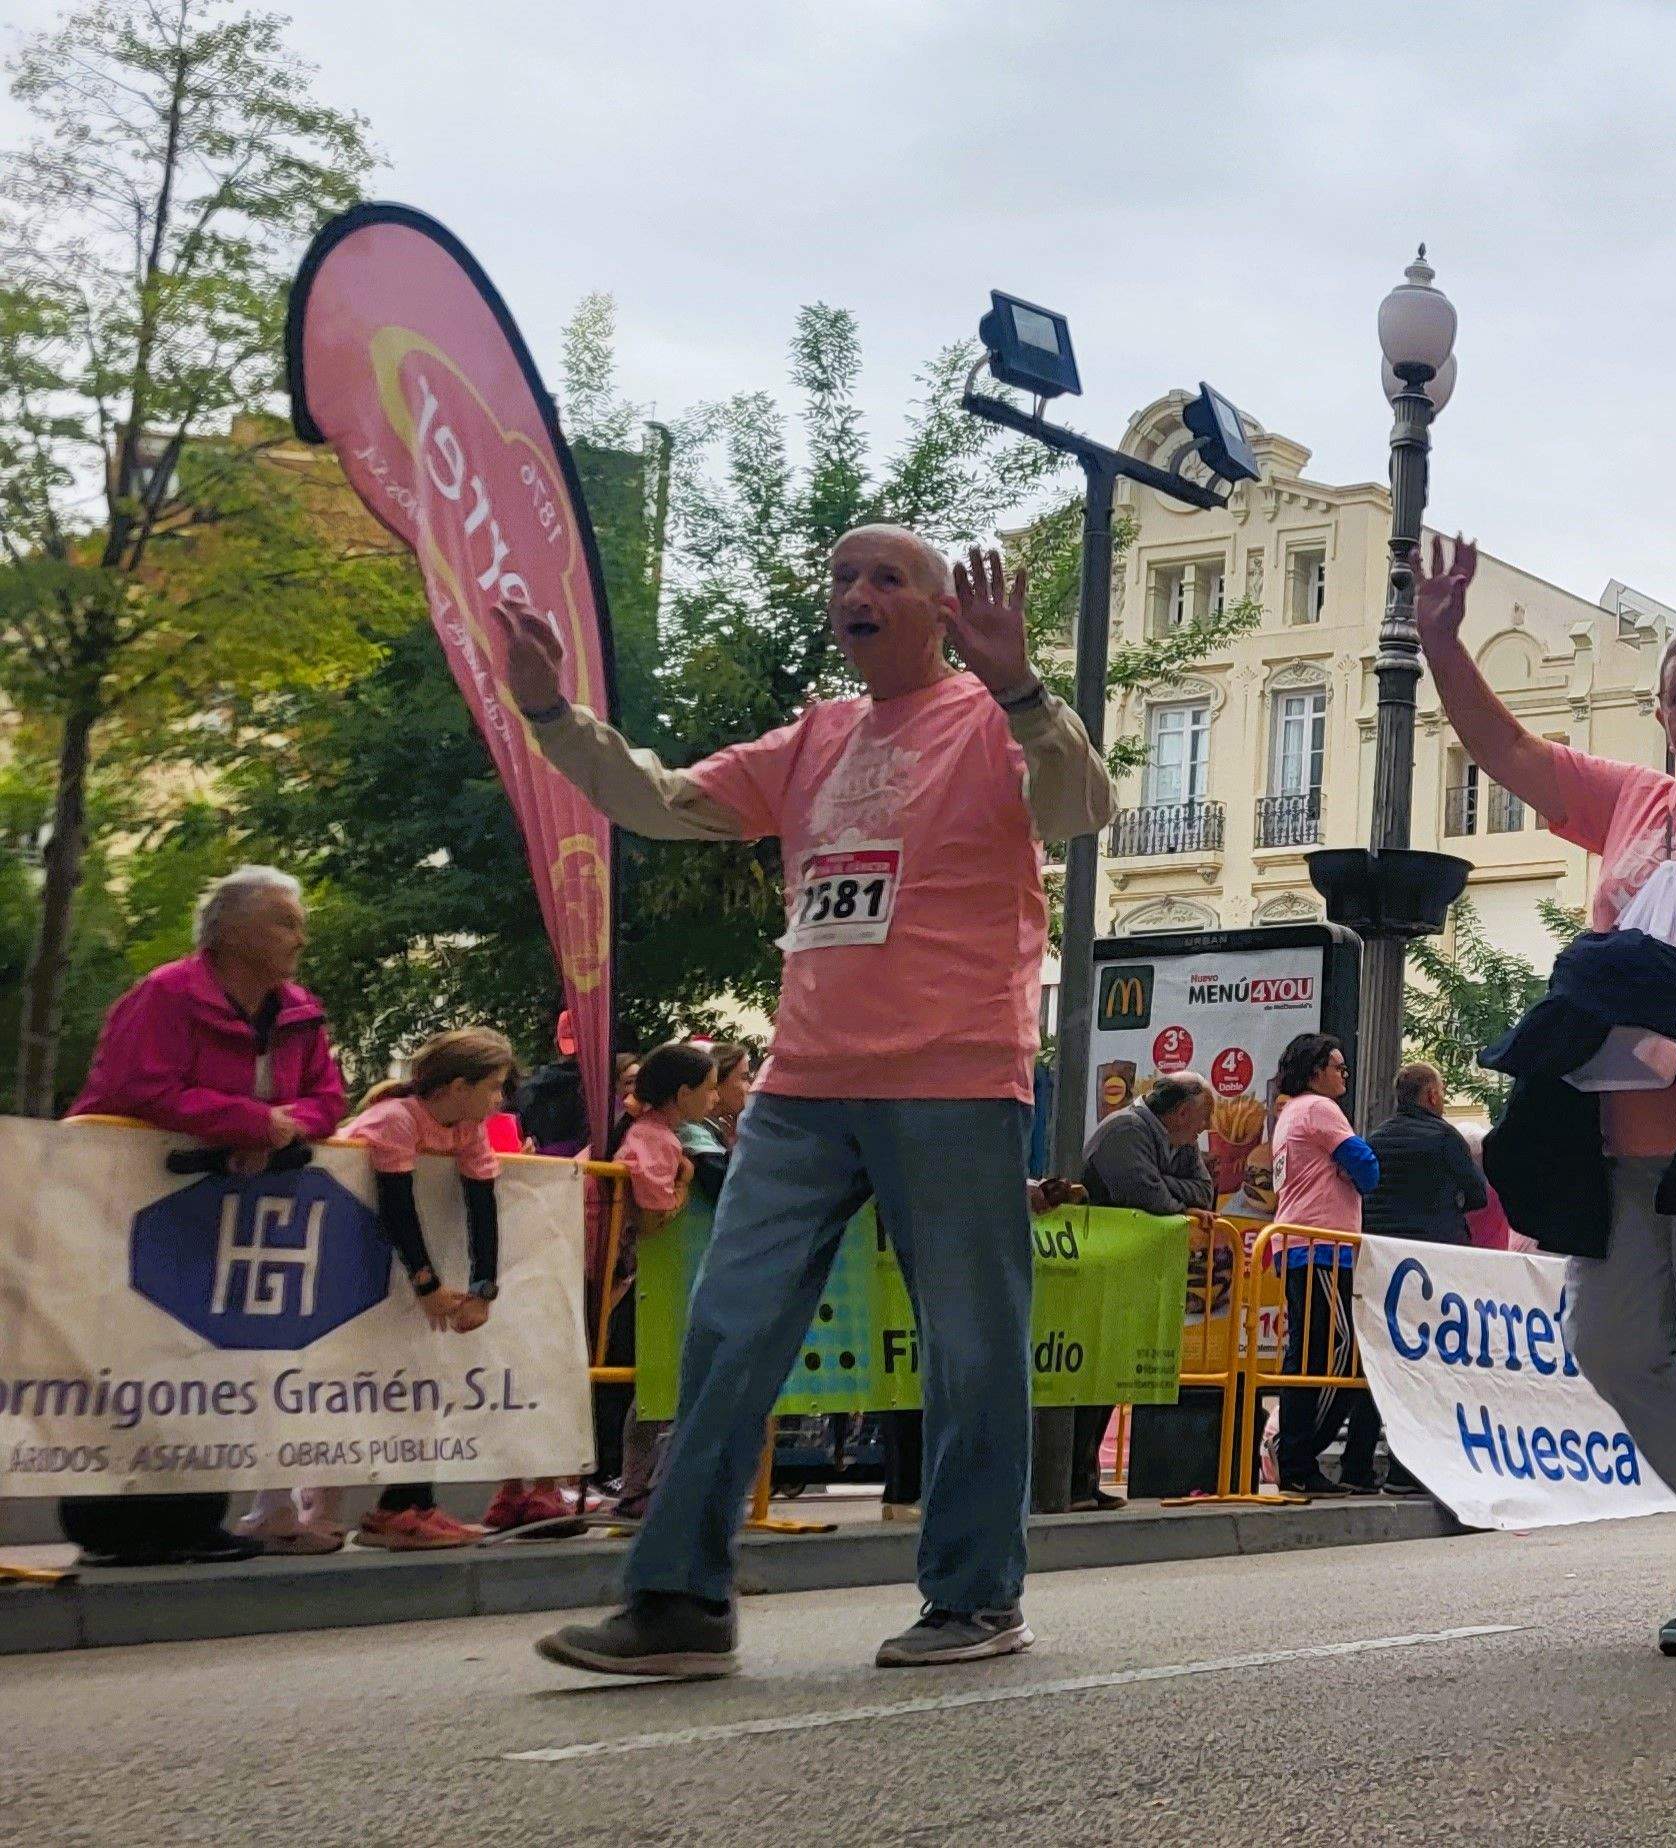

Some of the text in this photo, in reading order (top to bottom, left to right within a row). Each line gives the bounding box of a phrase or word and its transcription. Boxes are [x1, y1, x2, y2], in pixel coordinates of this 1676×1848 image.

[1219, 1082, 1244, 1091] Doble
[273, 1367, 455, 1418] Grañén,
[462, 1366, 539, 1411] S.L.
[129, 1442, 259, 1473] ASFALTOS
[277, 1440, 363, 1468] OBRAS
[369, 1434, 479, 1464] PÚBLICAS
[1456, 1401, 1642, 1487] Huesca
